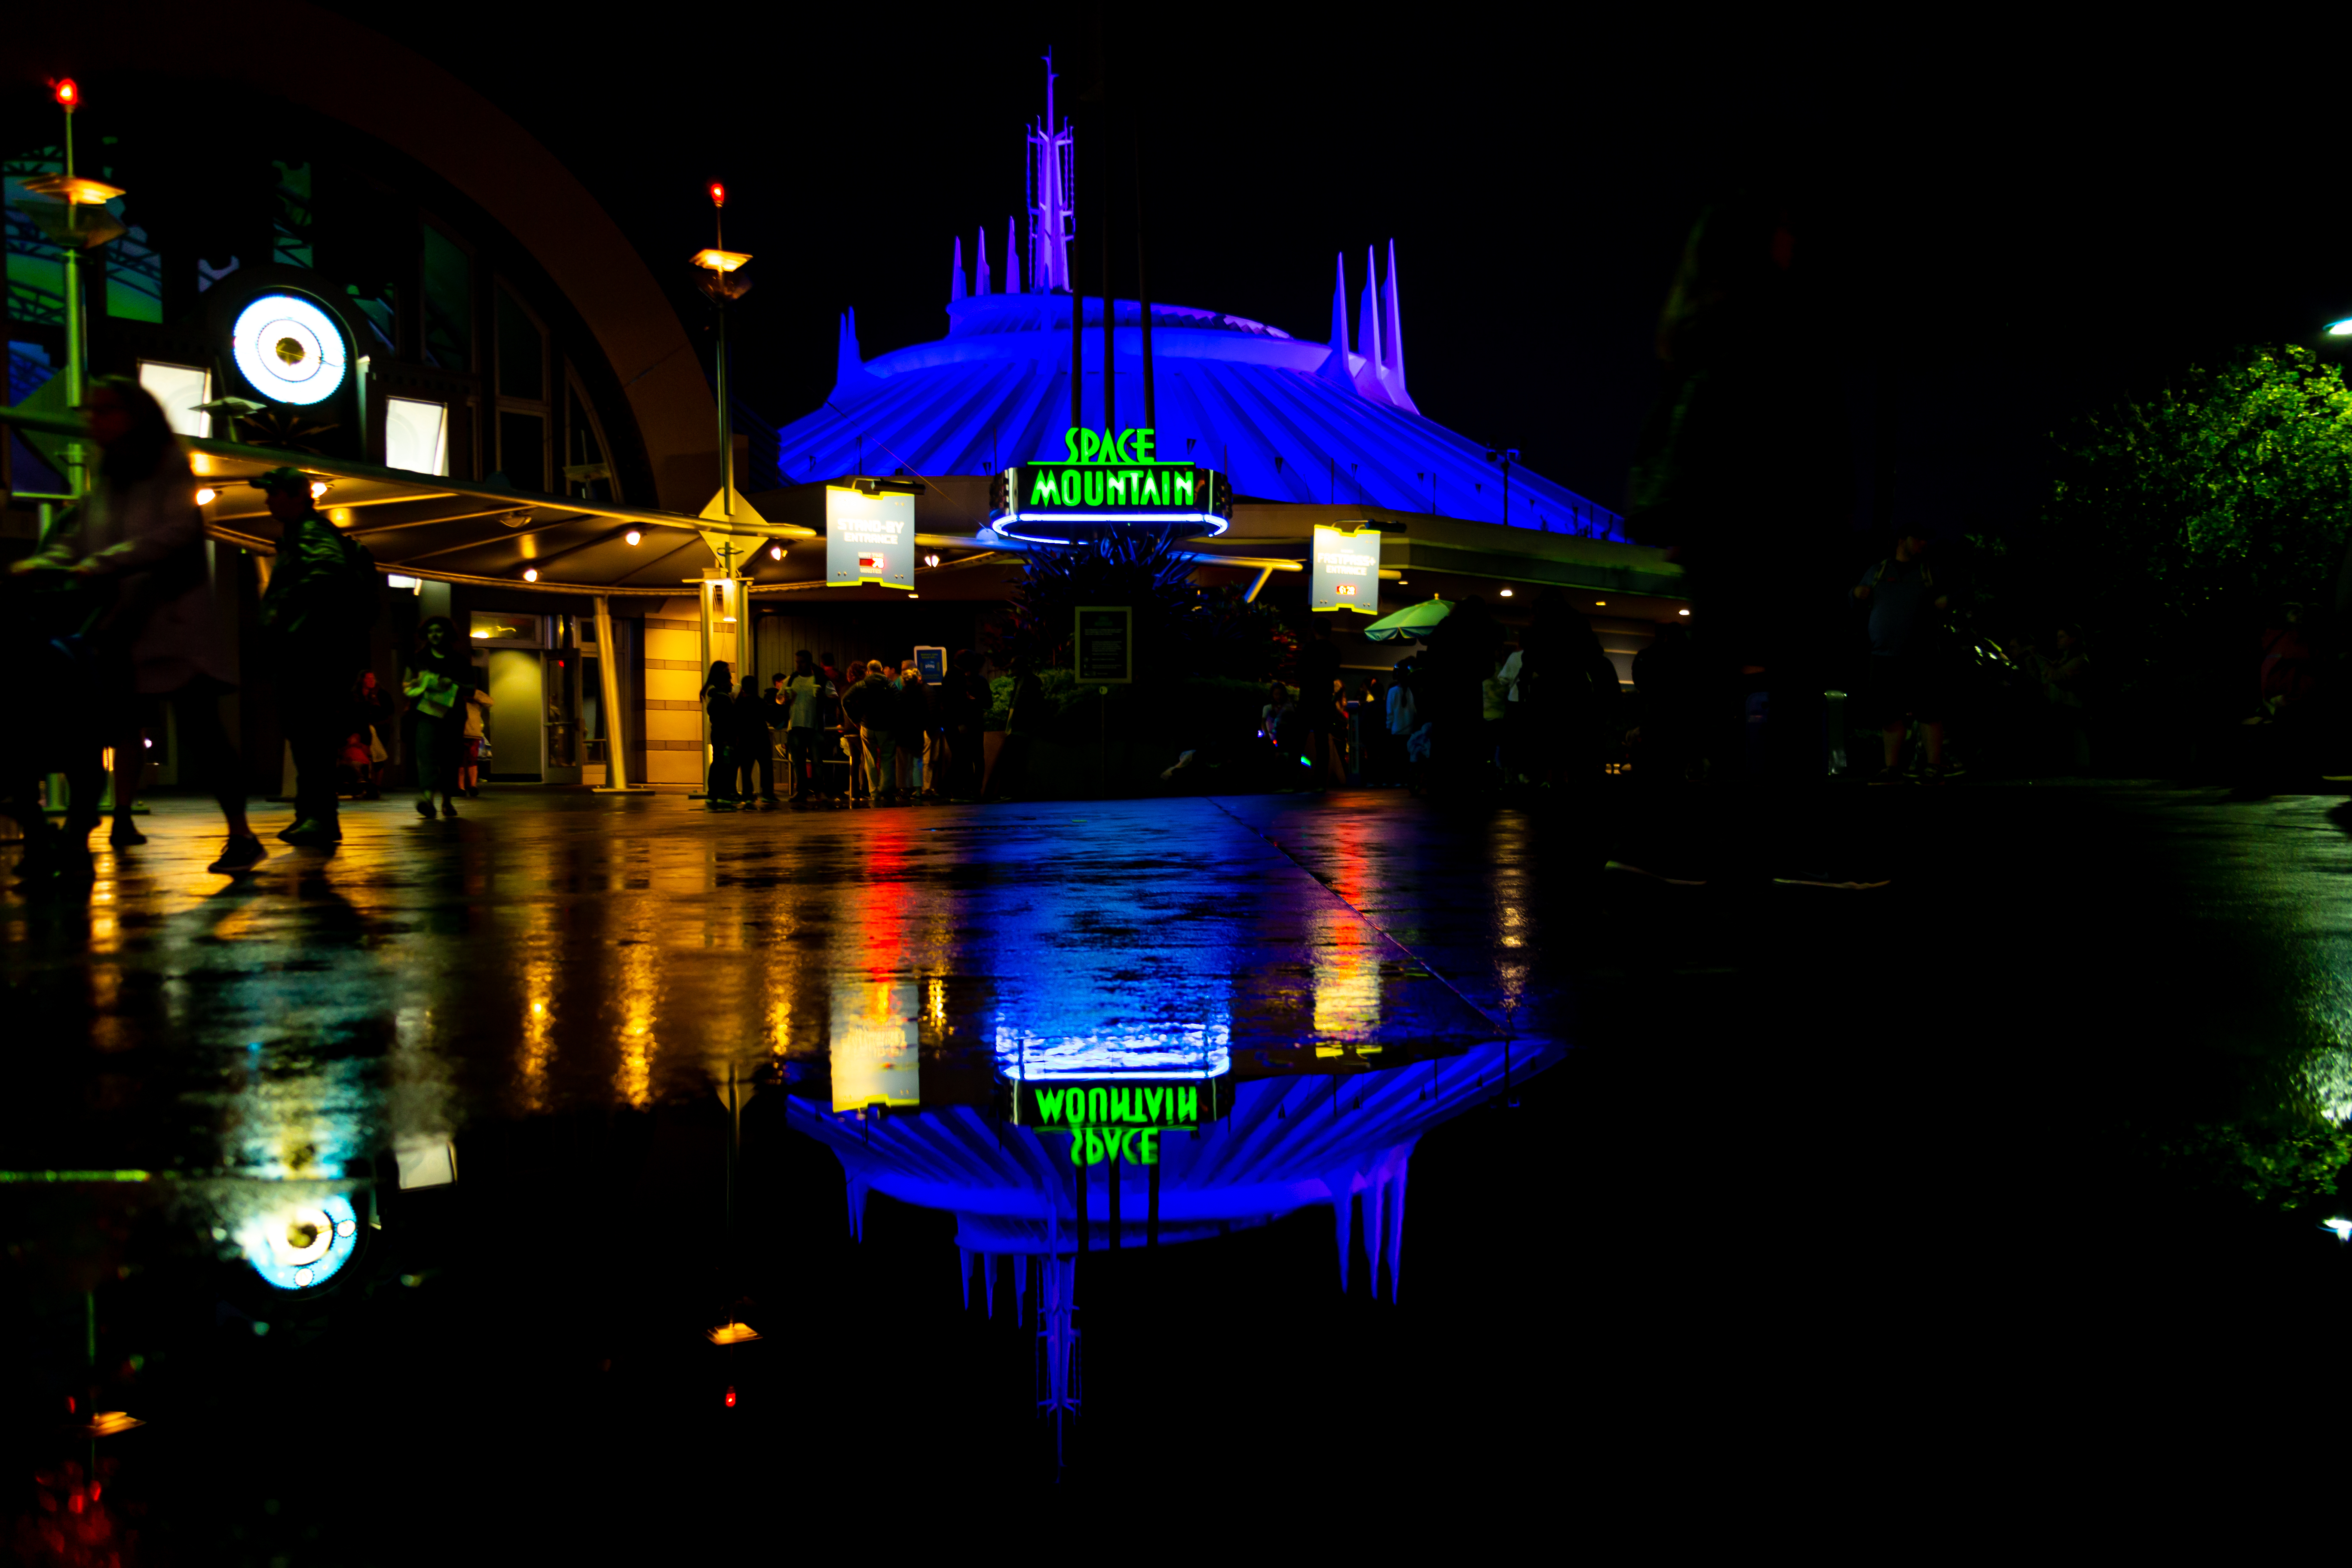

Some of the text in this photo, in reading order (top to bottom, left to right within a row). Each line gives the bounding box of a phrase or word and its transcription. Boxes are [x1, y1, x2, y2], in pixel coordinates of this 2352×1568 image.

[1065, 428, 1155, 463] SPACE
[1031, 469, 1194, 507] MOUNTAIN
[837, 518, 904, 533] STAND-BY
[844, 532, 898, 544] ENTRANCE
[1317, 553, 1376, 567] FASTPASS+
[1326, 564, 1367, 576] ENTRANCE
